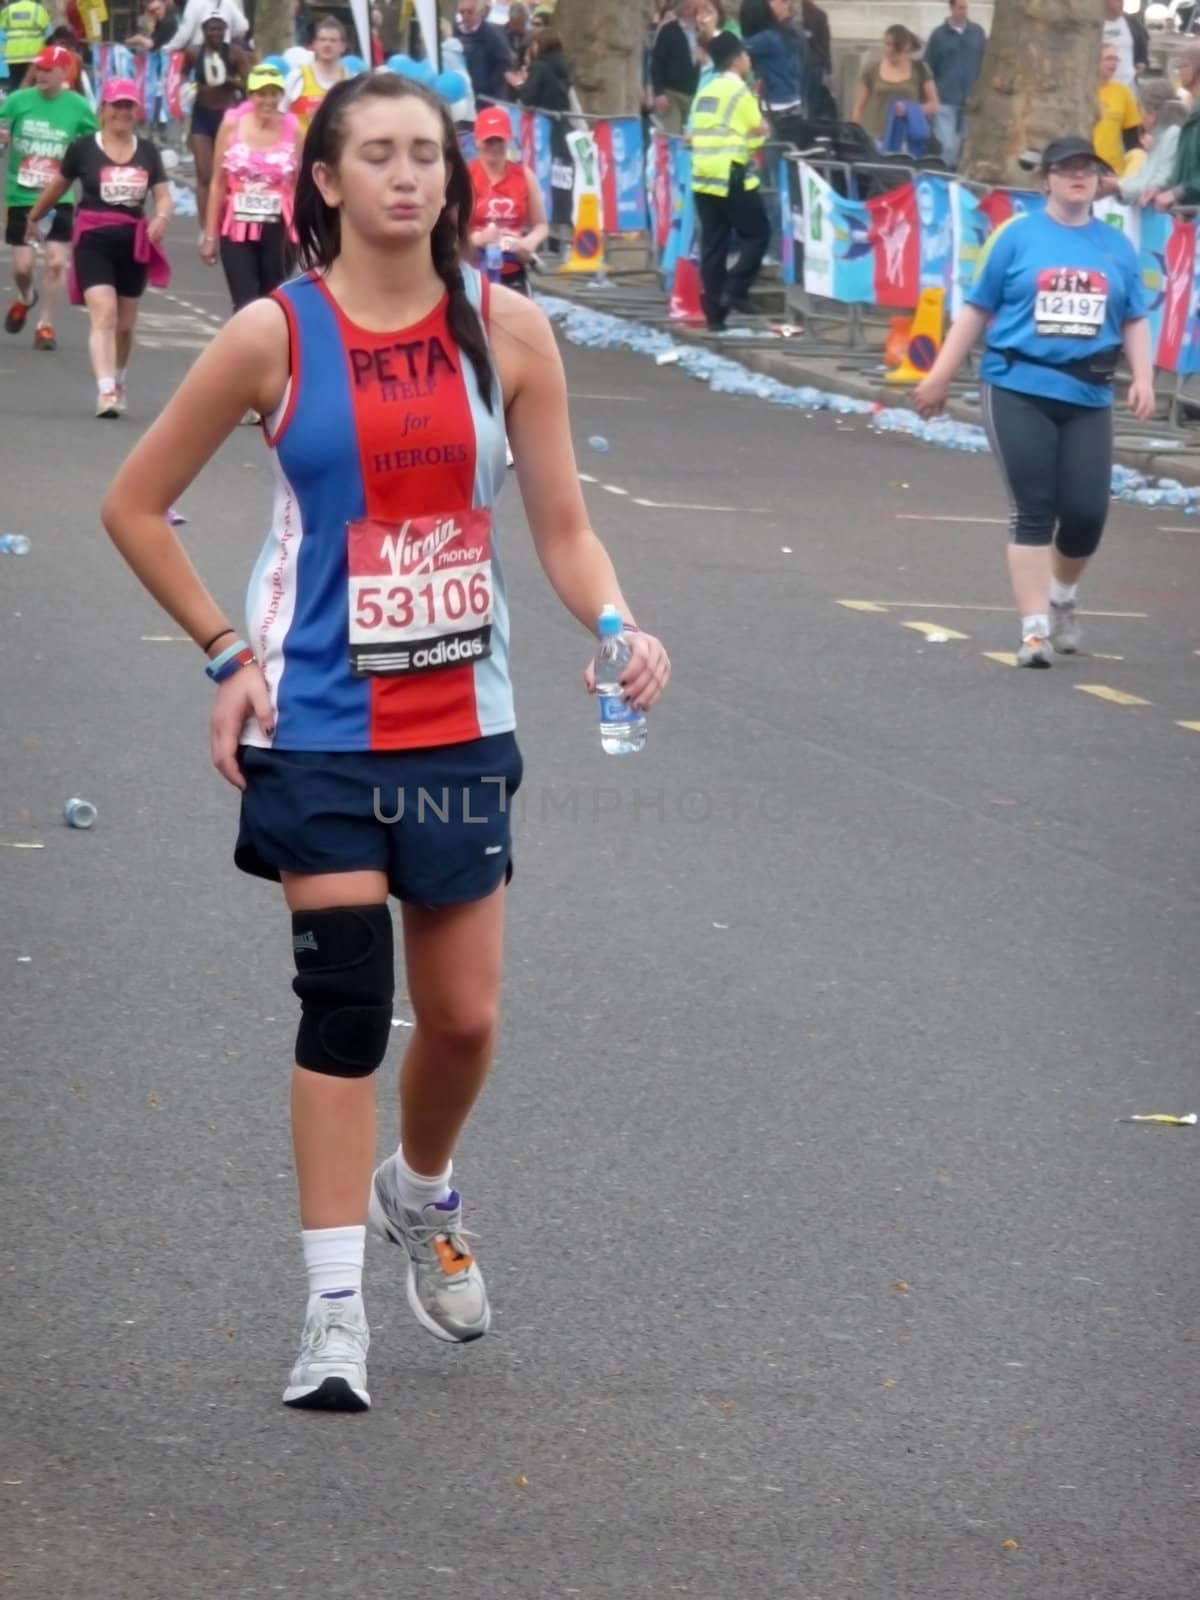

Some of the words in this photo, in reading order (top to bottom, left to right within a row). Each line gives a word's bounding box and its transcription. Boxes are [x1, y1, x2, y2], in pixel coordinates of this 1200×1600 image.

[1039, 296, 1105, 318] 12197
[349, 336, 457, 386] PETA
[381, 377, 438, 403] HELP
[401, 411, 431, 438] for
[374, 444, 468, 473] HEROES
[380, 518, 462, 577] Virgin
[438, 546, 484, 567] money
[355, 572, 490, 630] 53106
[413, 635, 484, 669] adidas
